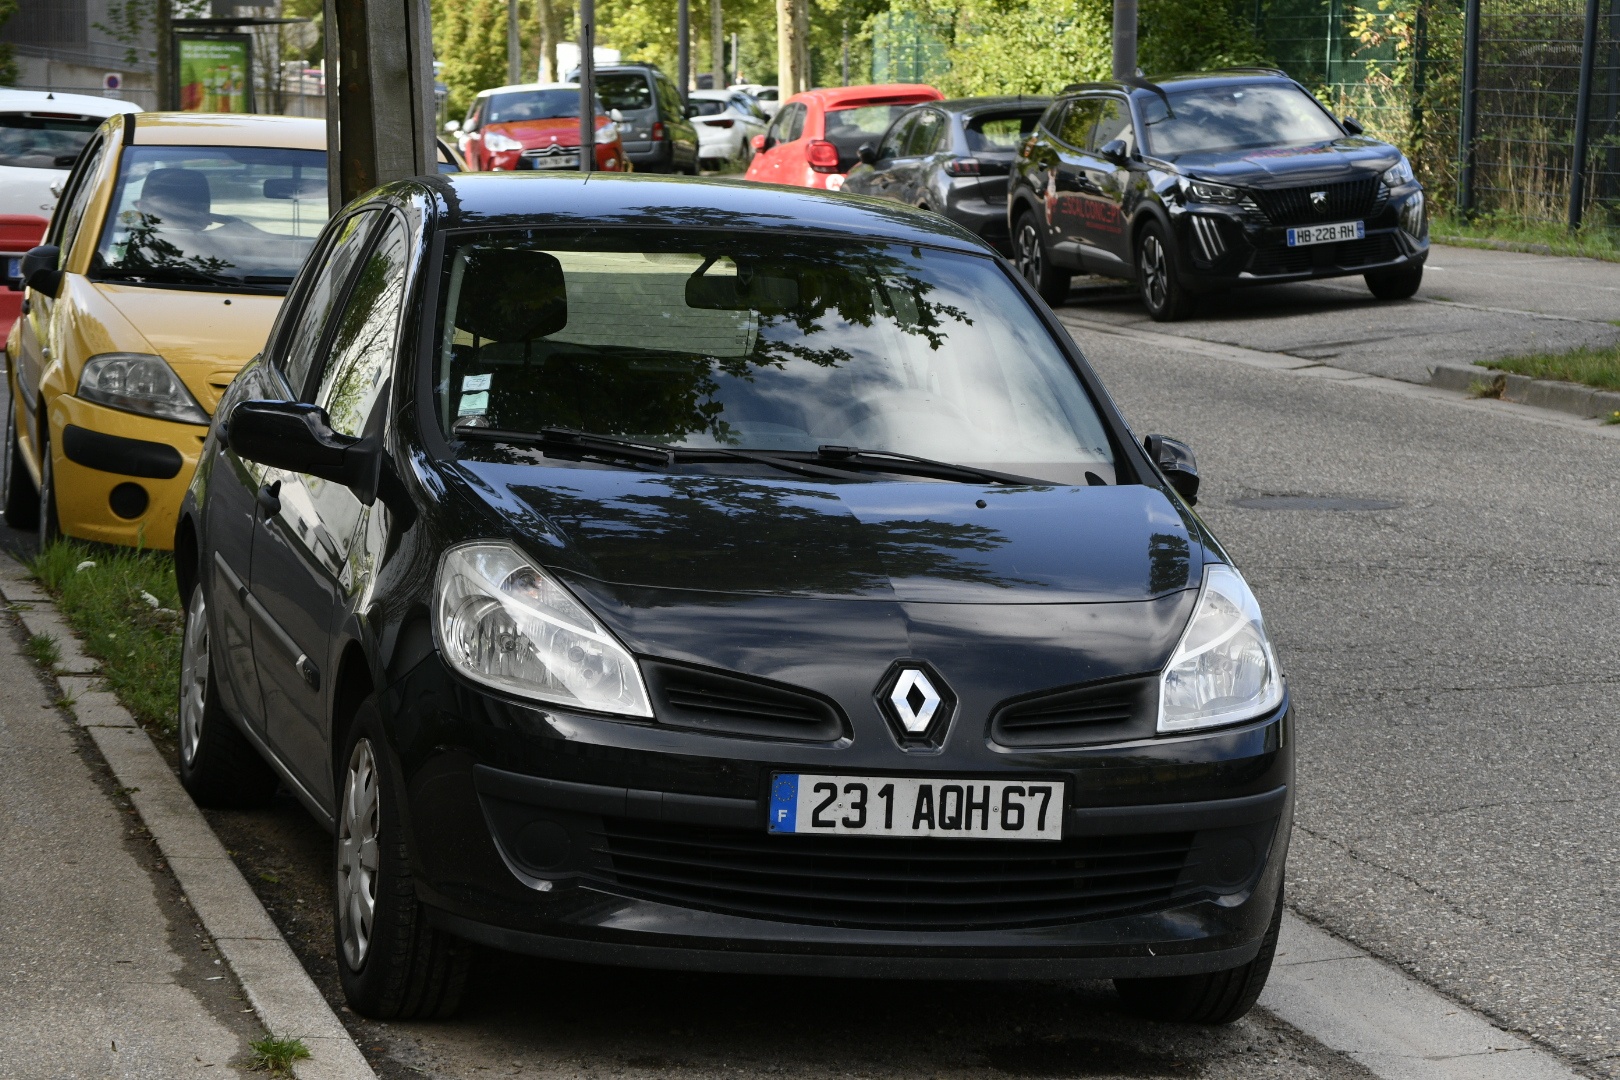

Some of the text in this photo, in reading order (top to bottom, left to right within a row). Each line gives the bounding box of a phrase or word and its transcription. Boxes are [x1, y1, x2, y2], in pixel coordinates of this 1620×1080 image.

[778, 809, 787, 823] F
[812, 782, 1052, 831] 231 AQH 67
